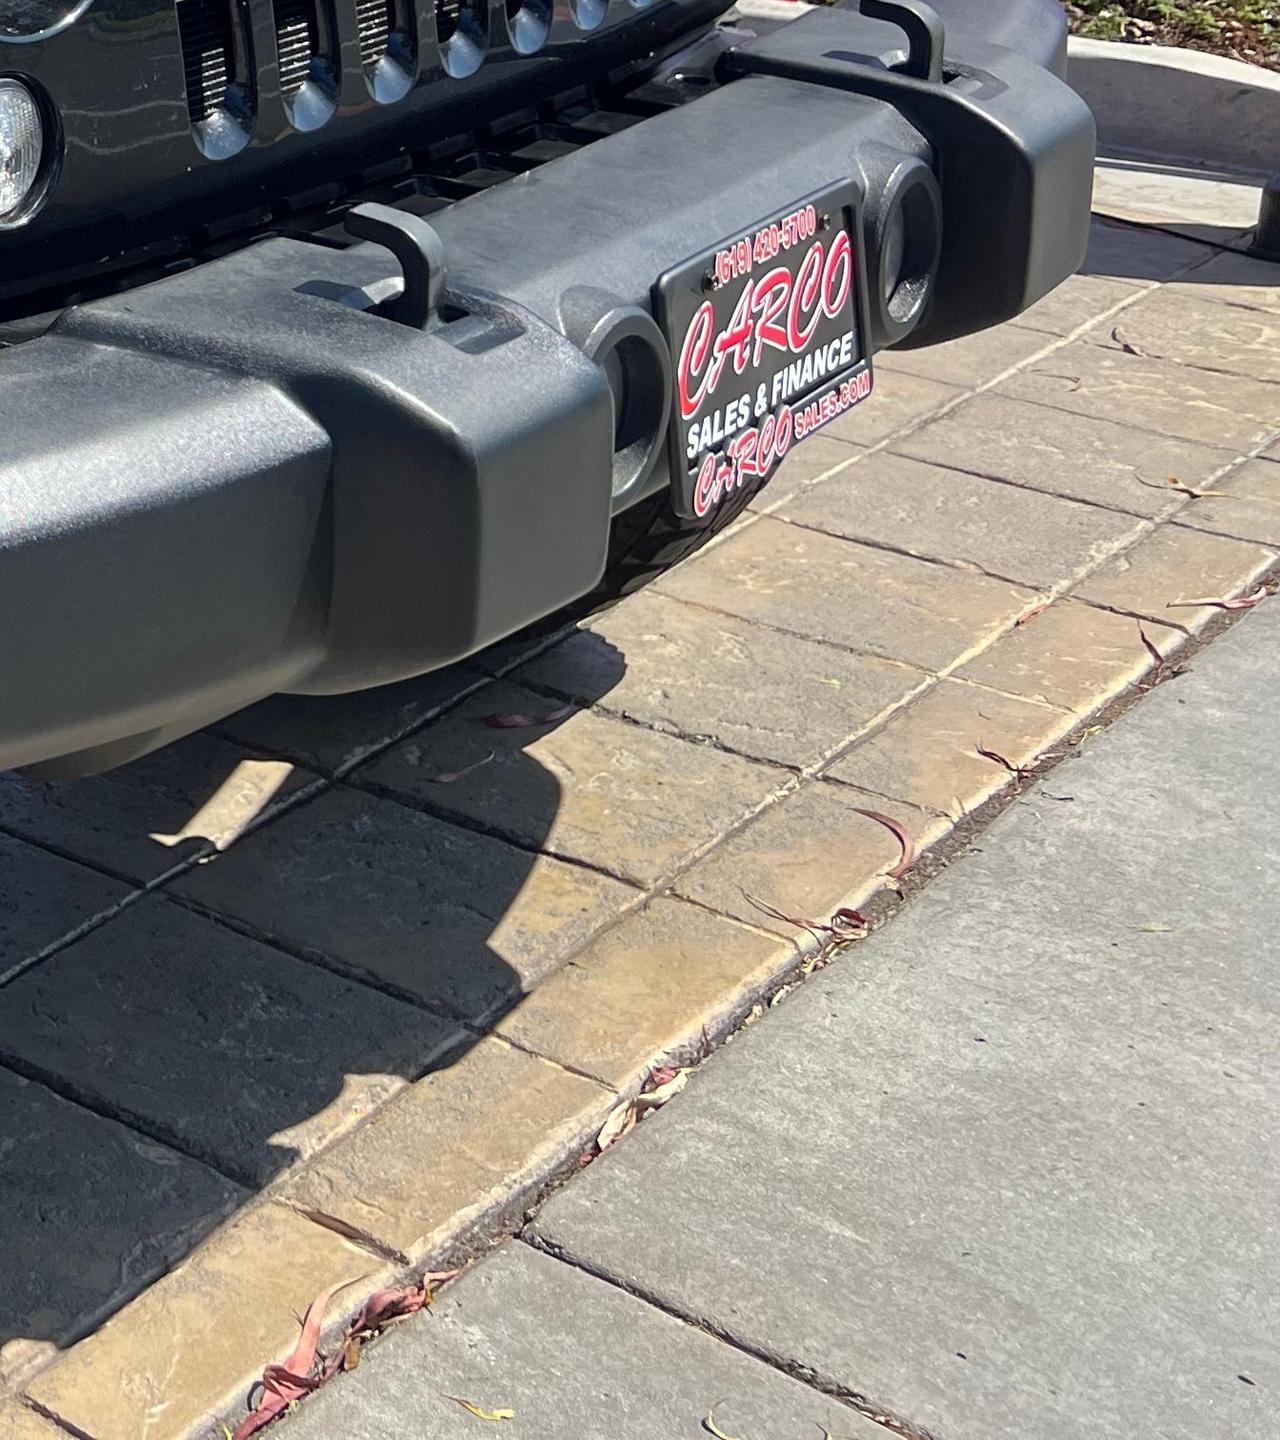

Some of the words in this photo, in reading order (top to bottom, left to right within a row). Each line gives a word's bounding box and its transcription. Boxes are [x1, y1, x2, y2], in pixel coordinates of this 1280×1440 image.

[713, 236, 753, 287] (619)
[753, 204, 817, 265] 420-5700
[677, 229, 853, 421] CARCO
[686, 392, 751, 459] SALES
[753, 381, 769, 418] &
[770, 330, 855, 407] FINANCE
[693, 404, 794, 518] CARCO
[794, 368, 872, 440] SALES.COM
